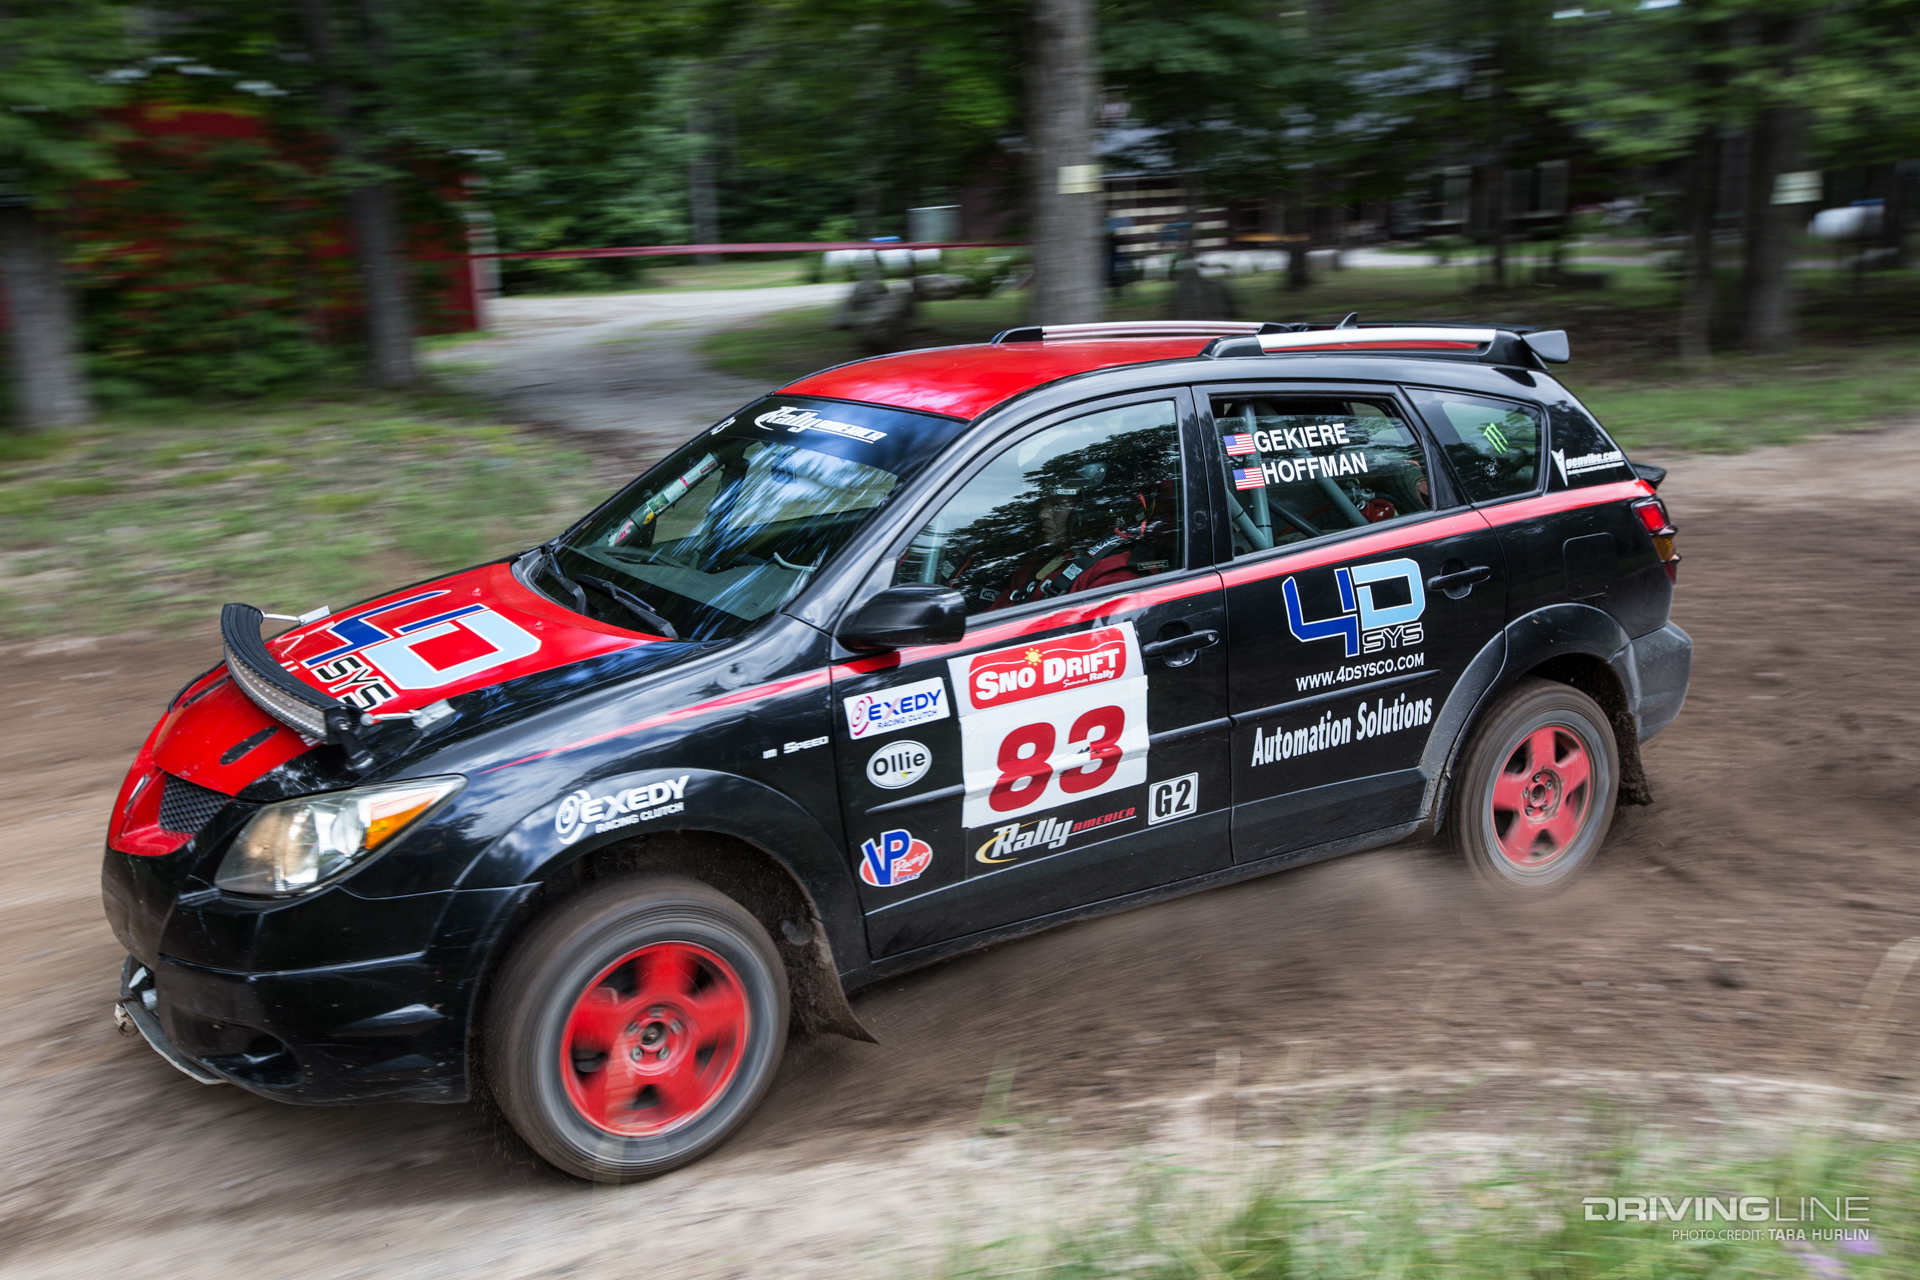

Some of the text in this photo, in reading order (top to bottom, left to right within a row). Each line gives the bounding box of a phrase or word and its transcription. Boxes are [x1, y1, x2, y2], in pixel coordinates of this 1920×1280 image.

[755, 406, 823, 433] Rally
[1254, 423, 1350, 452] GEKIERE
[1261, 452, 1368, 484] HOFFMAN
[1282, 558, 1426, 658] 4D
[300, 589, 542, 690] 4D
[1363, 622, 1424, 654] SYS
[310, 654, 399, 713] SYS
[975, 648, 1120, 701] SNO DRIFT
[1089, 670, 1115, 681] Rally
[1296, 653, 1425, 691] WWW.4DSYSCO.COM
[868, 689, 942, 721] EXEDY
[877, 710, 938, 729] RACING CLUTCH
[1251, 693, 1433, 767] Automation Solutions
[873, 751, 926, 776] Ollie
[989, 705, 1125, 812] 83
[579, 775, 690, 824] EXEDY
[595, 802, 684, 833] RACING CLUTCH
[1154, 779, 1192, 818] G2
[989, 807, 1136, 859] Rally AMERICA
[861, 830, 912, 886] VP
[894, 851, 930, 877] Racing
